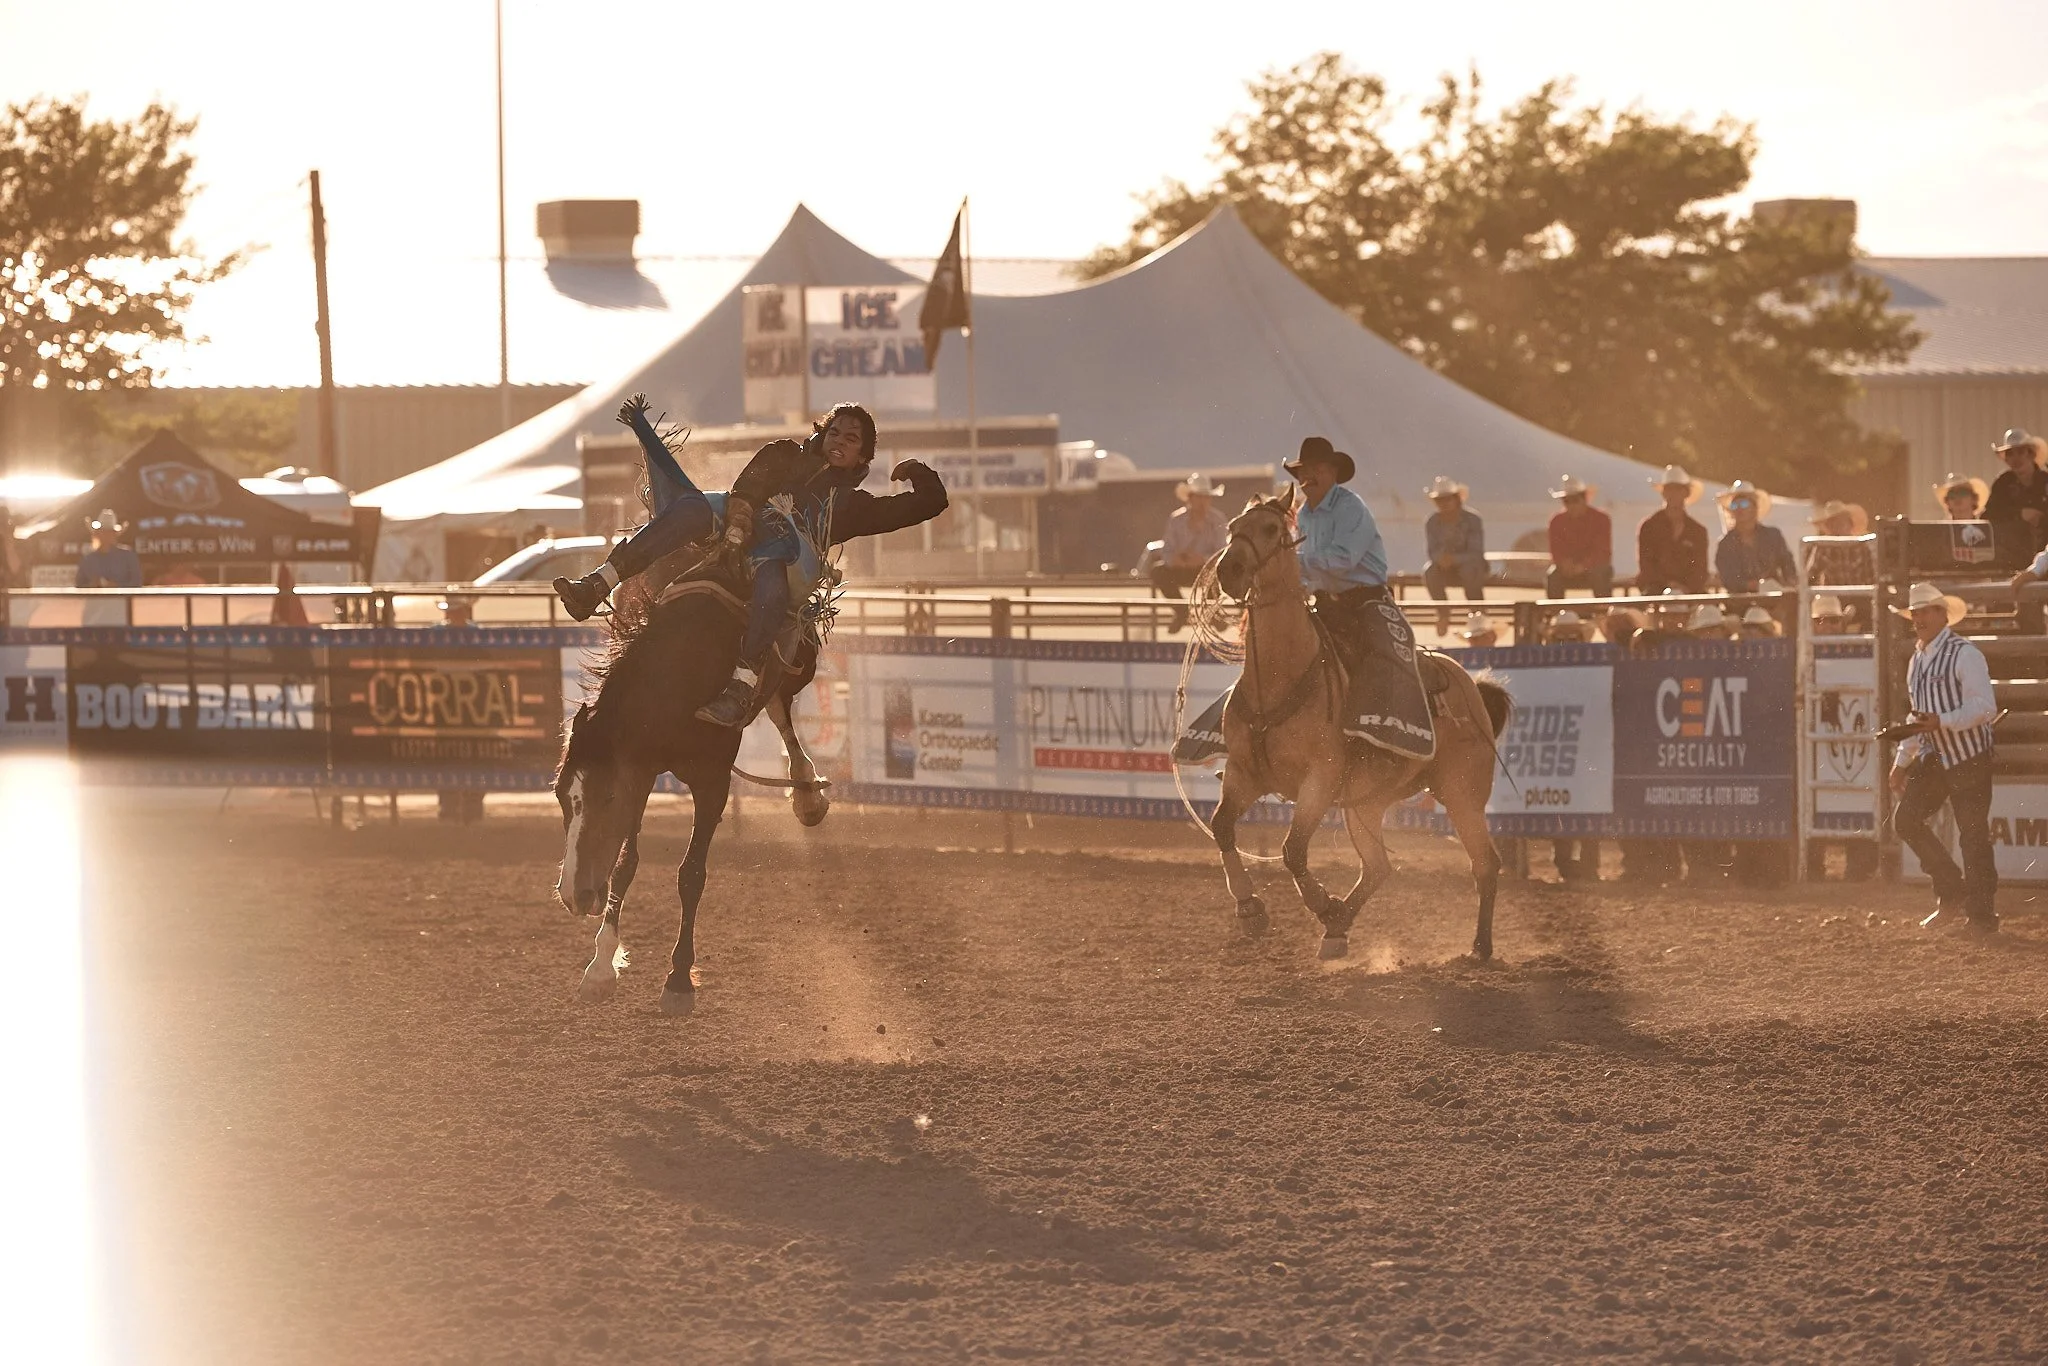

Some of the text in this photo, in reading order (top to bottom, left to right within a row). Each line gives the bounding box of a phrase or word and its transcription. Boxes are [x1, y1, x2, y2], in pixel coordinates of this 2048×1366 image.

[842, 292, 898, 330] ICE
[811, 338, 931, 377] CREAM
[5, 677, 57, 722] H
[75, 684, 315, 729] BOOT BARN
[368, 668, 535, 725] CORRAL
[1656, 677, 1748, 738] CEAT
[1031, 687, 1177, 746] PLATINUM
[1359, 714, 1433, 742] RAM
[1507, 705, 1584, 742] RIDE
[1185, 729, 1224, 745] RAM
[1657, 743, 1747, 767] SPECIALTY
[919, 752, 964, 772] Center
[1501, 745, 1578, 777] PASS
